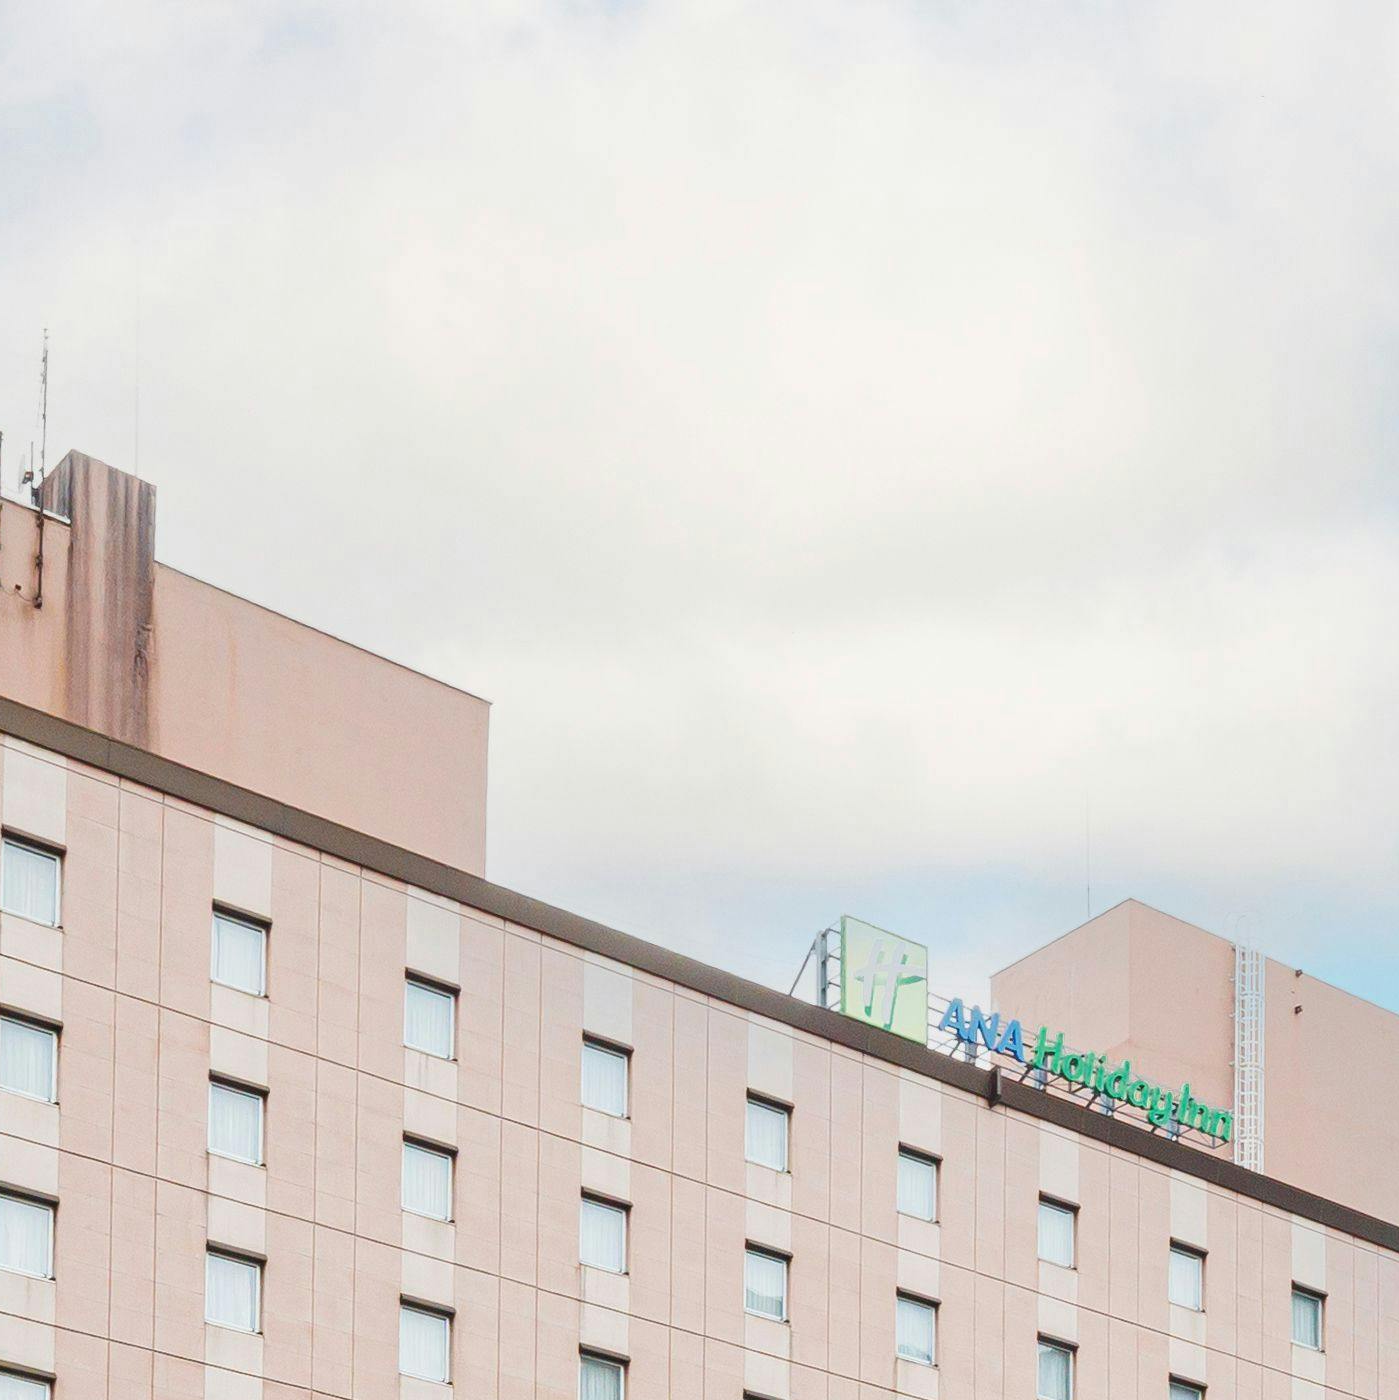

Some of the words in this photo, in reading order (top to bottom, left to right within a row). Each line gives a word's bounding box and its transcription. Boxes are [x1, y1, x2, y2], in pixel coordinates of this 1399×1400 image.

[939, 998, 1025, 1063] ANA
[1032, 1026, 1173, 1127] Holiday
[1176, 1083, 1233, 1142] Inn
